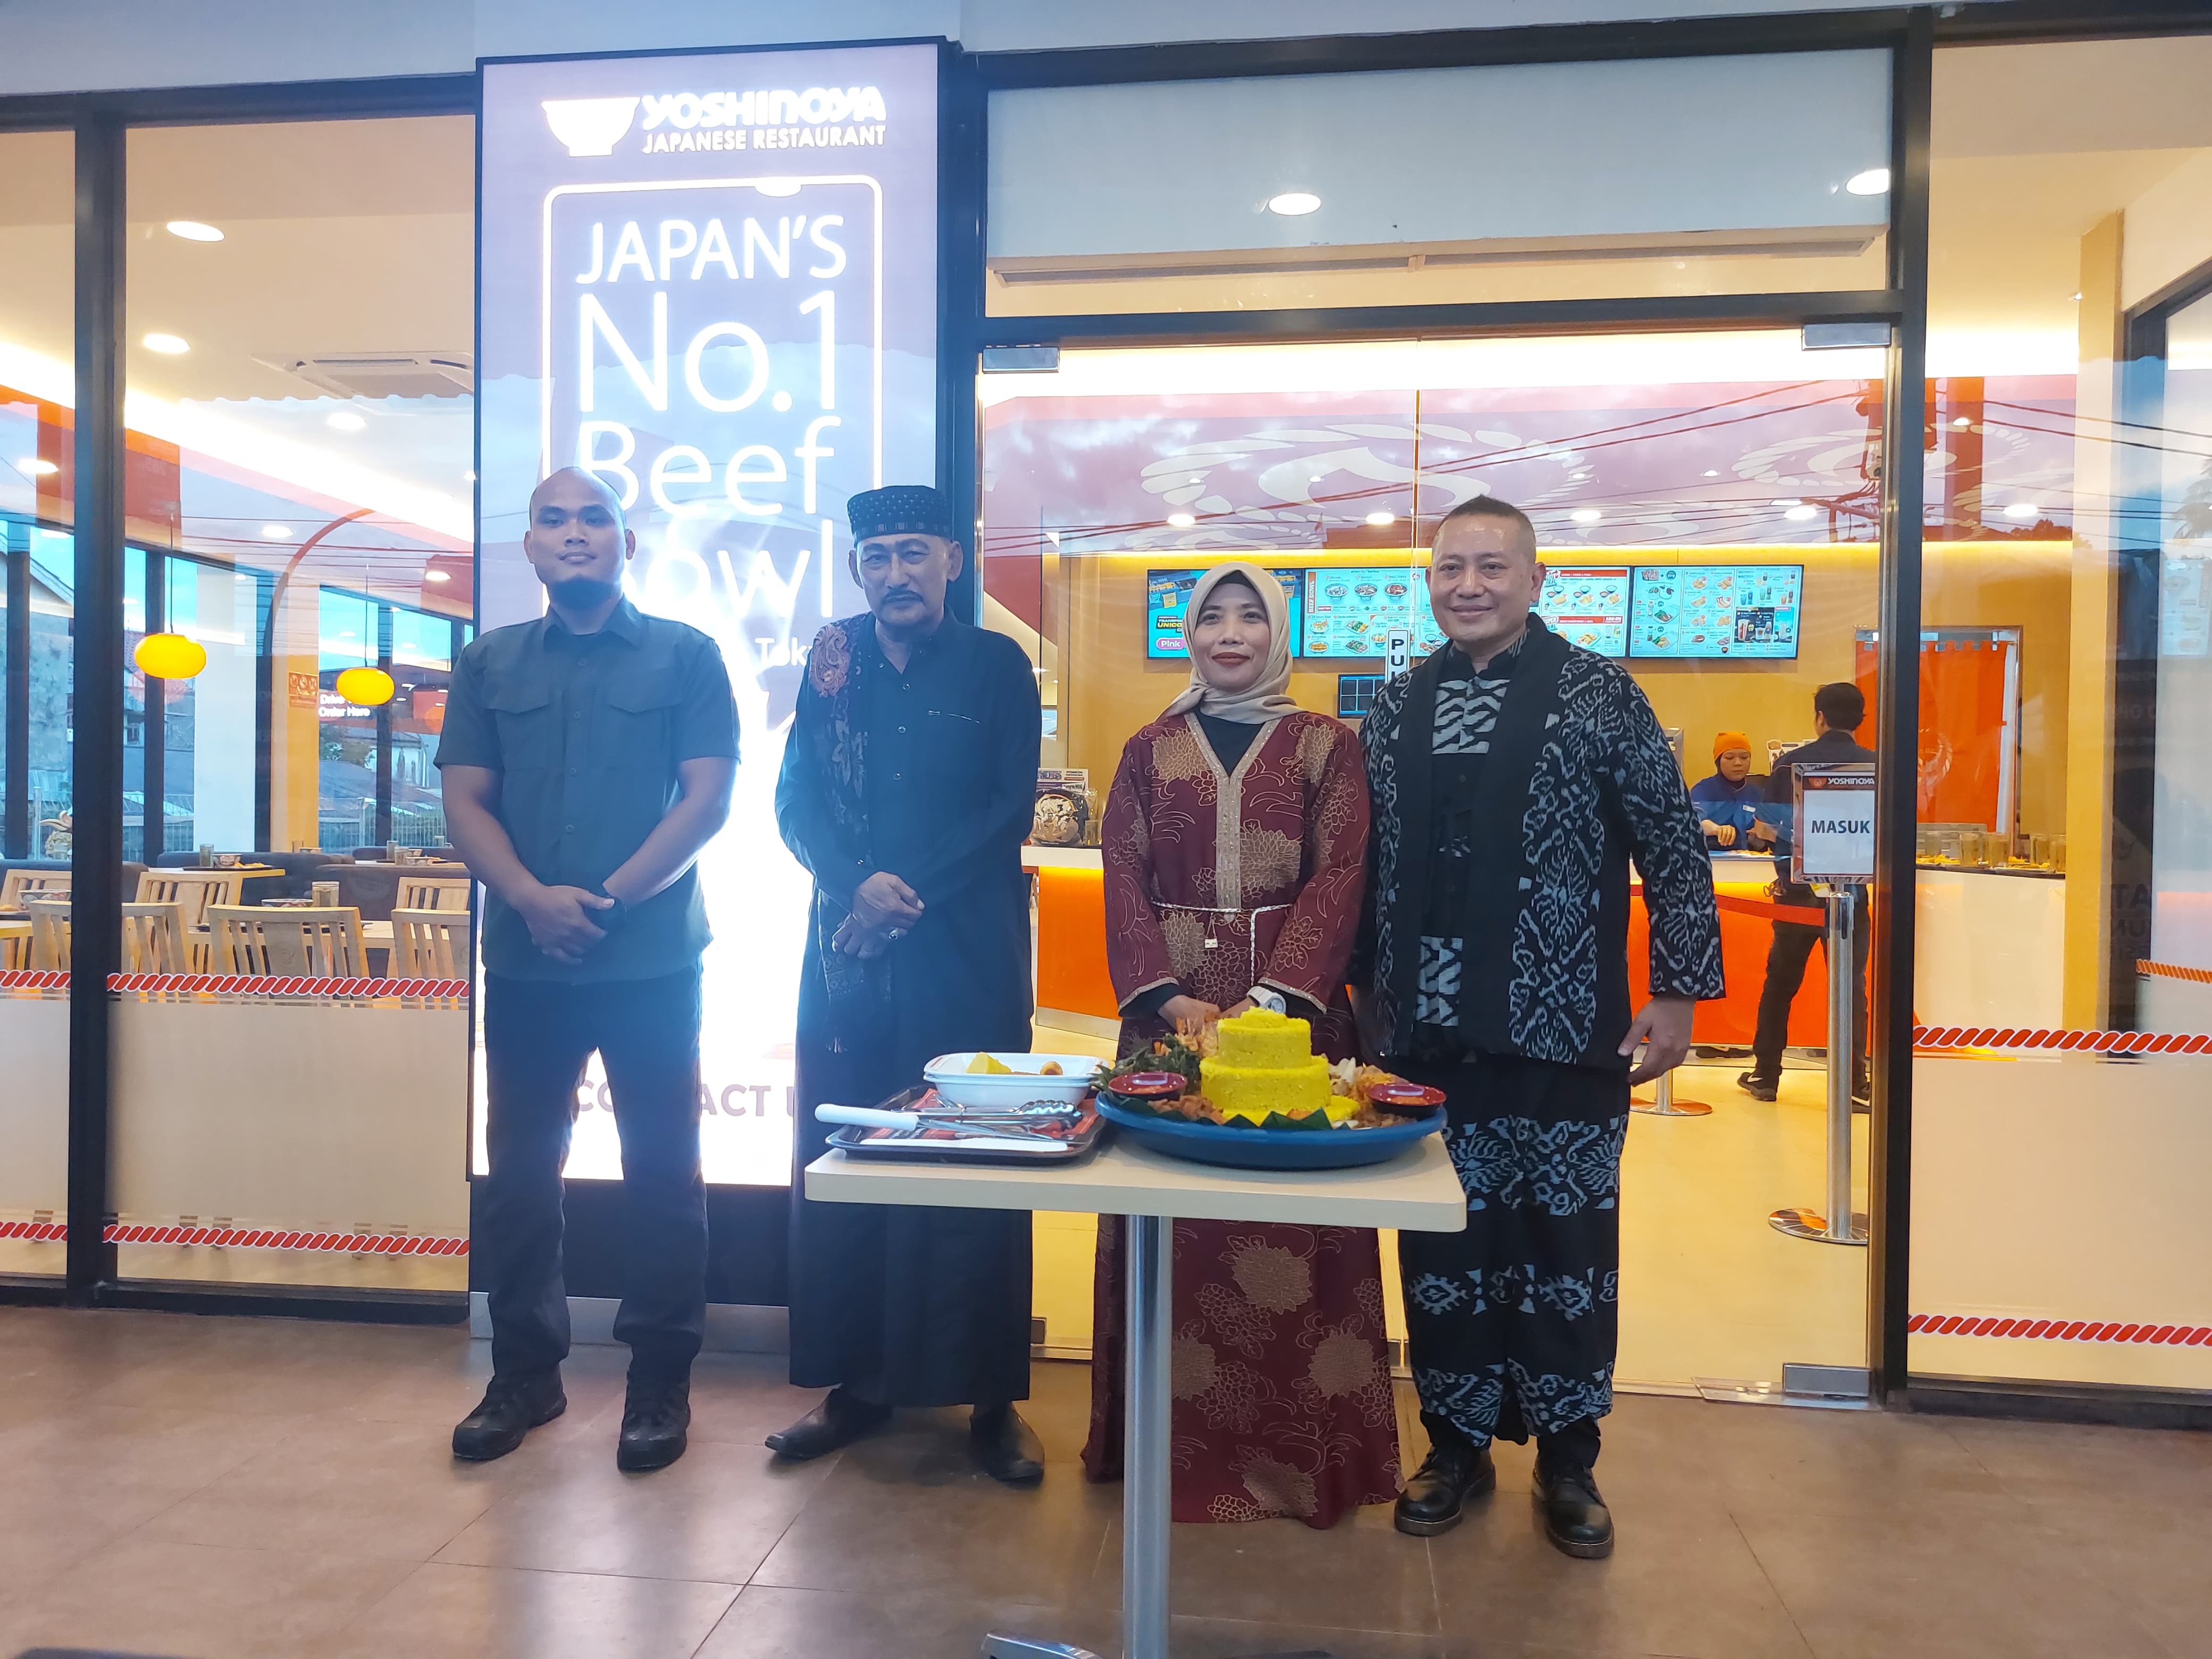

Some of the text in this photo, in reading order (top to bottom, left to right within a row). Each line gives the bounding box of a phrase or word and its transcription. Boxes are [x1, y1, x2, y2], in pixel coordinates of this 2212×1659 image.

[642, 125, 886, 154] JAPANESE RESTAURANT
[576, 215, 847, 284] JAPAN'S
[579, 289, 837, 412] No.1
[580, 415, 842, 516] Beef
[622, 519, 833, 618] owl
[755, 637, 812, 666] Tok
[1812, 820, 1871, 834] MASUK
[579, 1079, 771, 1116] COACT
